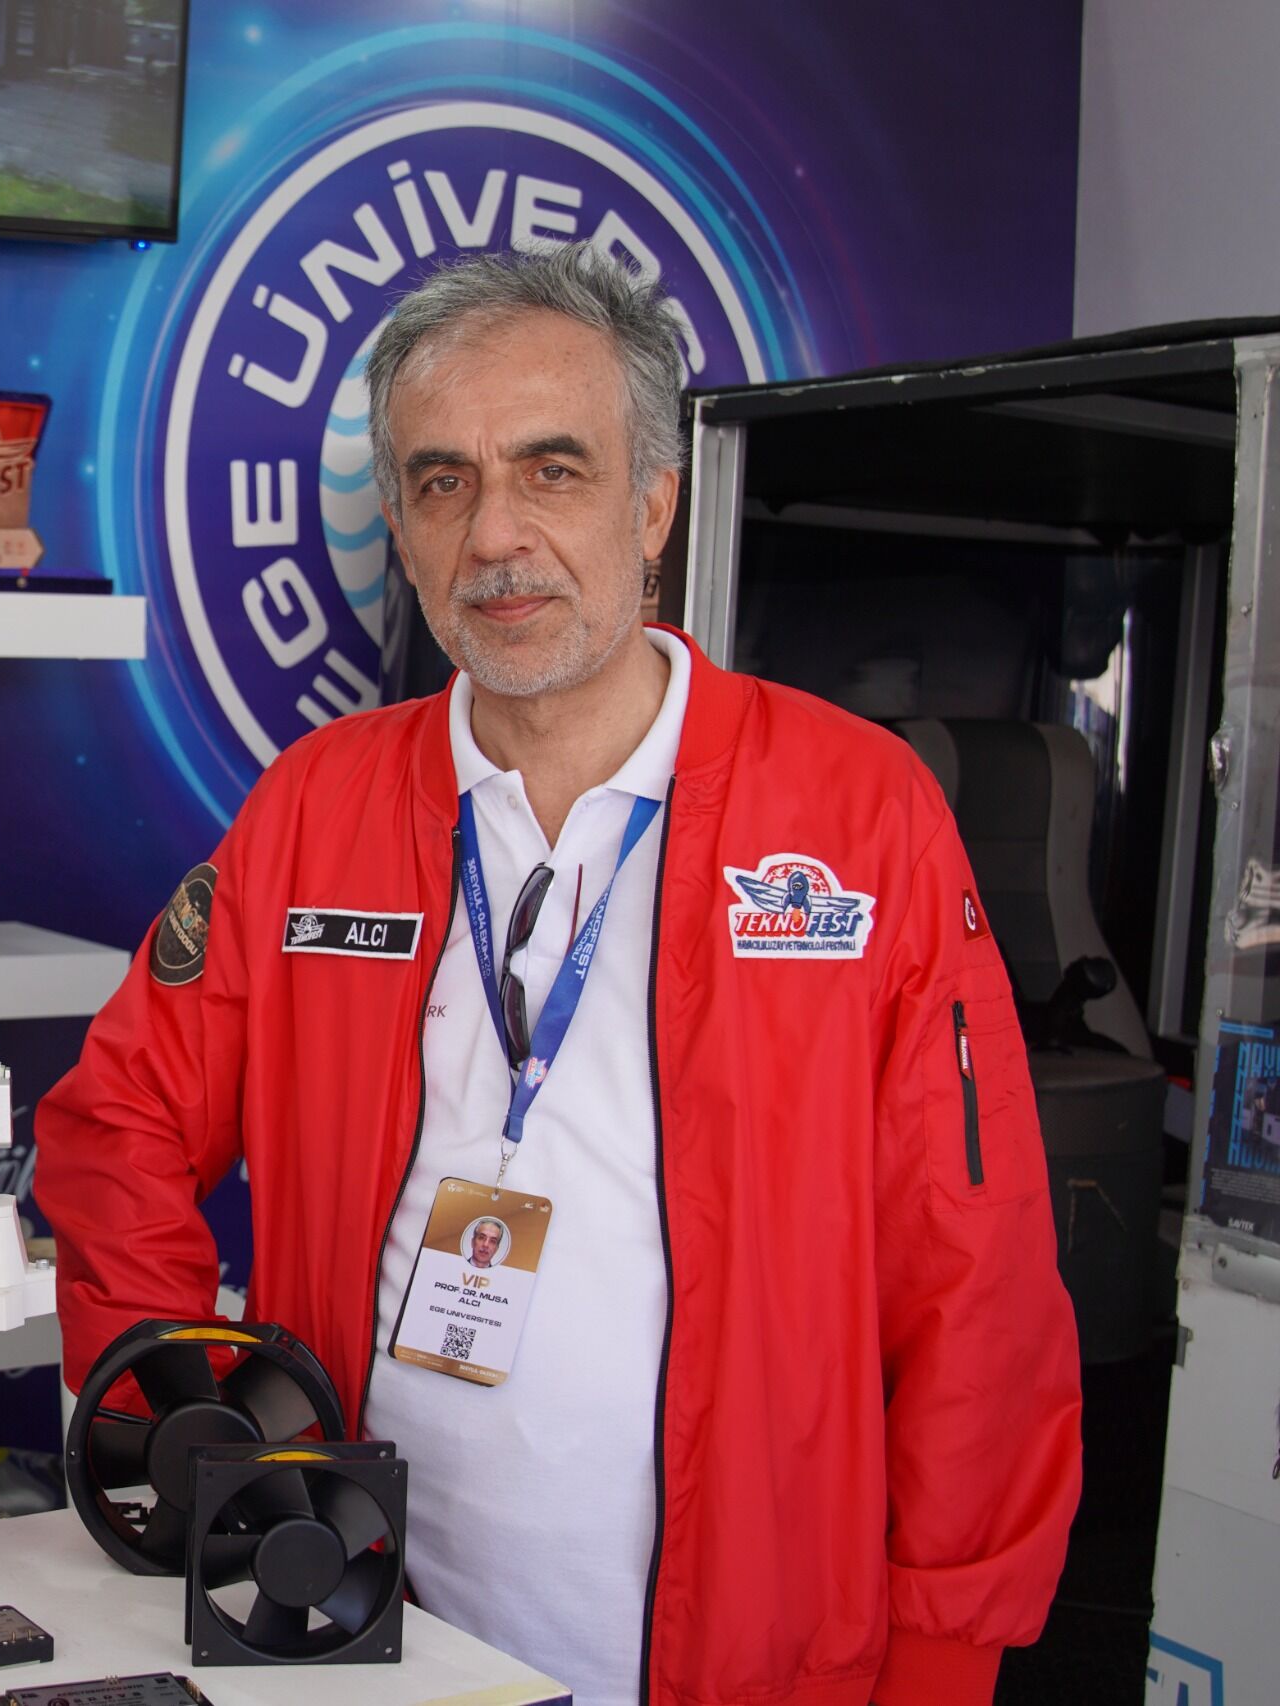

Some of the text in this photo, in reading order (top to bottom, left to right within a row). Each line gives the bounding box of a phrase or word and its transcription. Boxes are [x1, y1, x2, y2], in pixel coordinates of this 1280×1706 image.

[344, 921, 388, 947] ALCI
[734, 911, 864, 937] TEKNOFEST
[462, 1272, 490, 1290] VIP
[434, 1281, 509, 1305] PROF. DR. MUSA
[458, 1296, 480, 1308] ALCI
[429, 1304, 446, 1315] EGE
